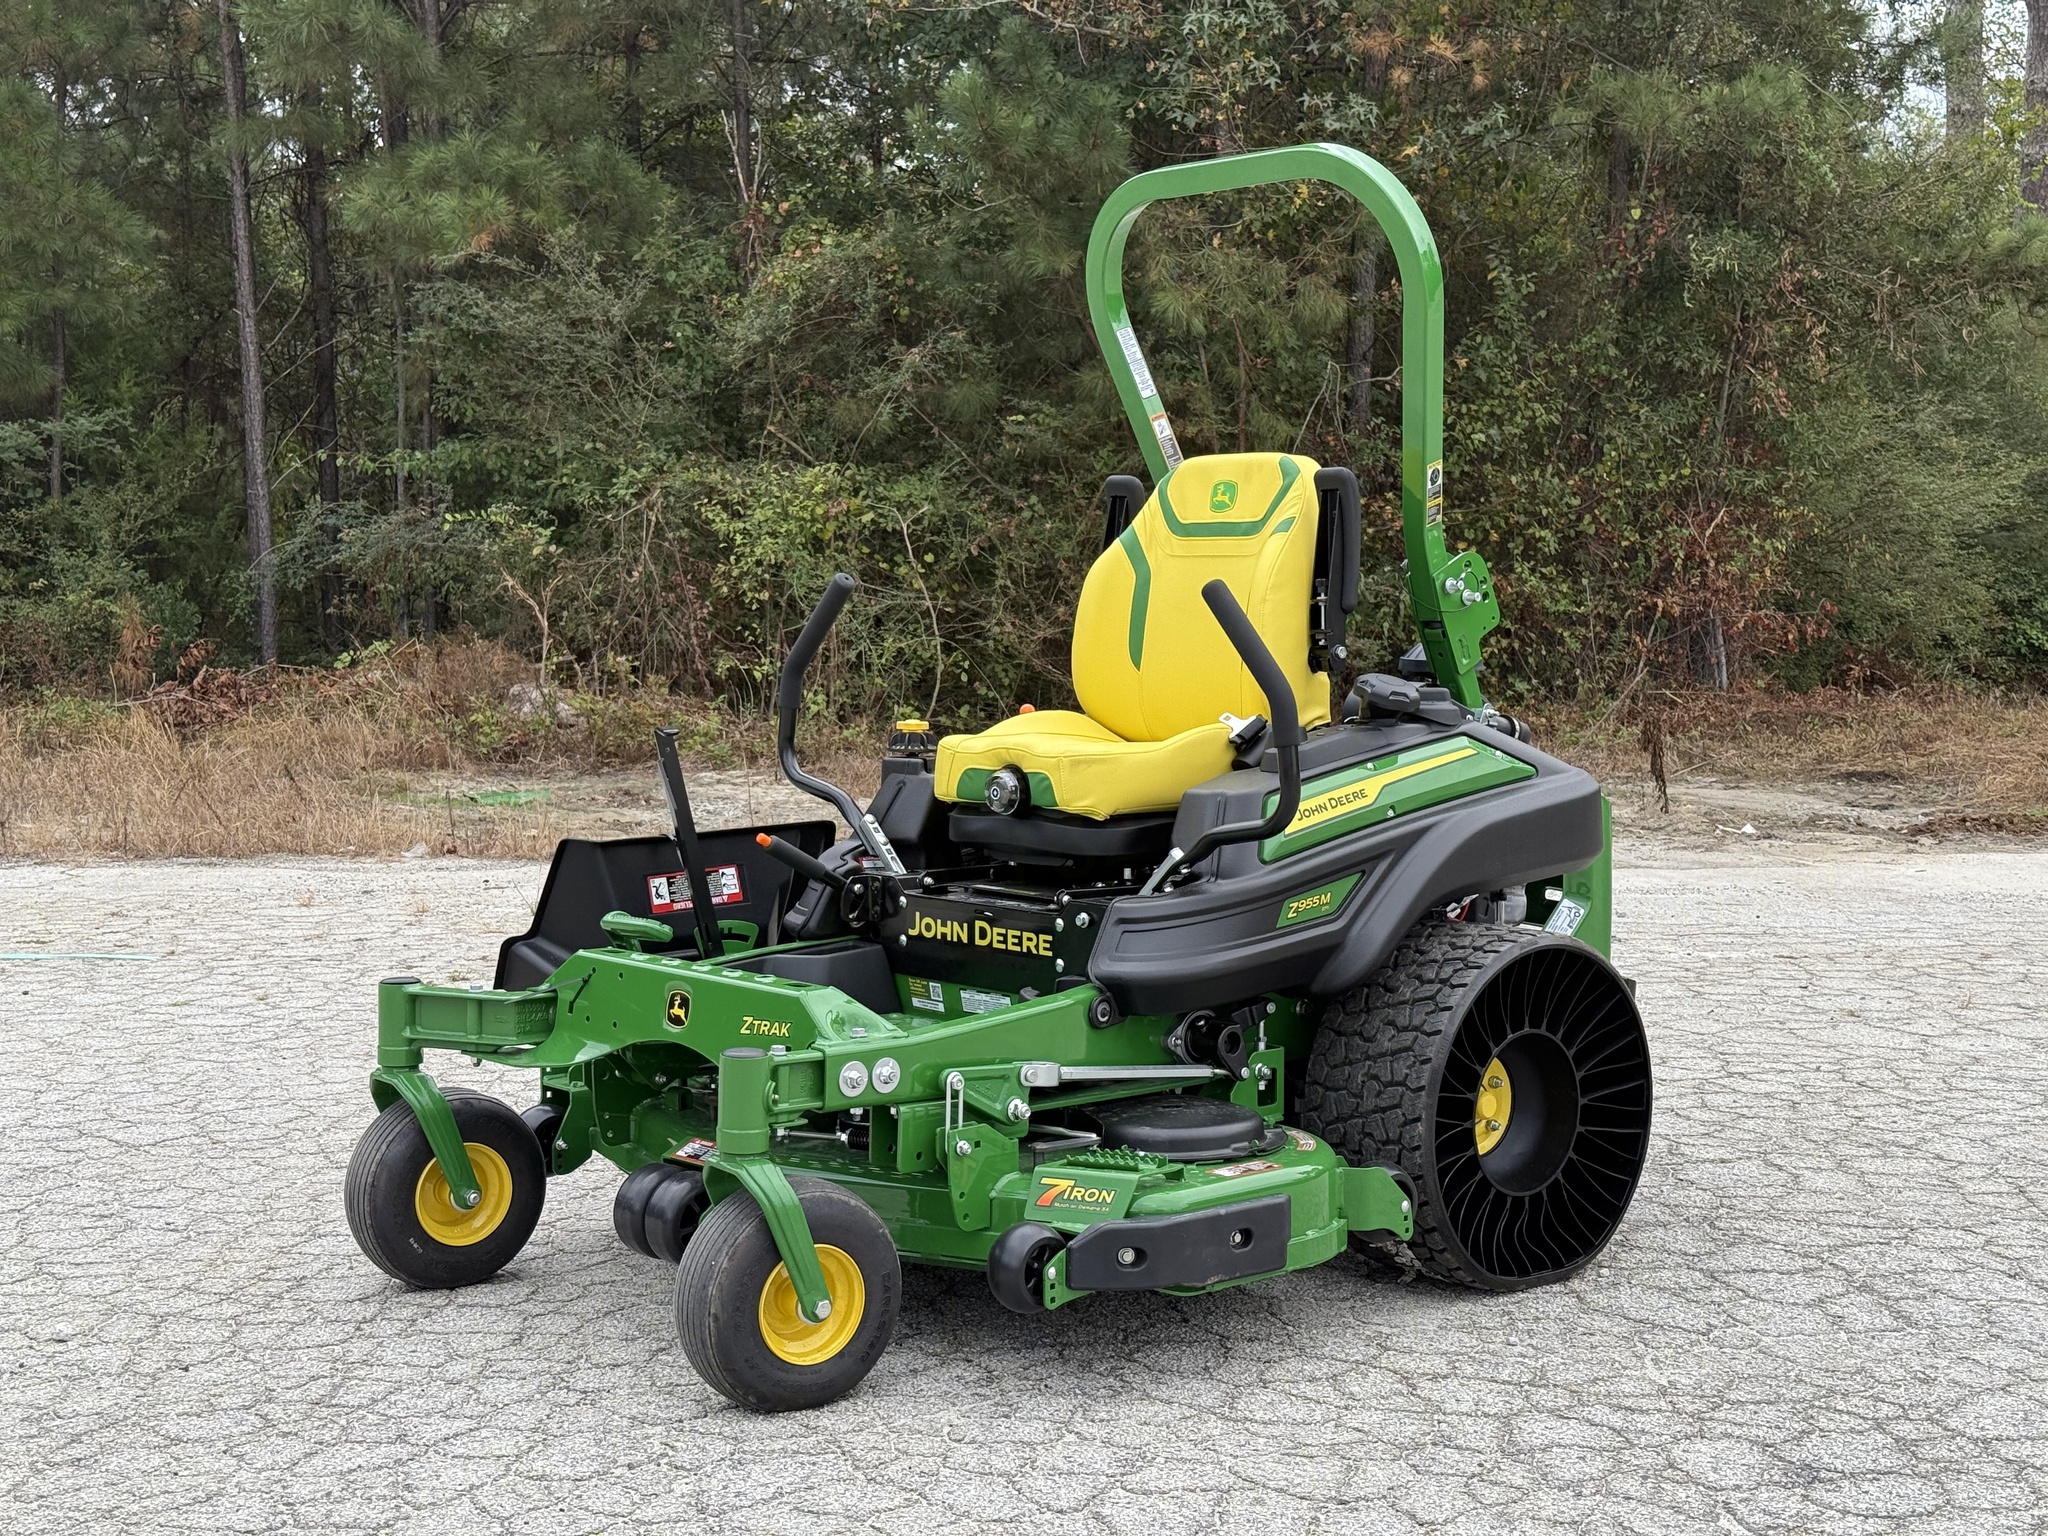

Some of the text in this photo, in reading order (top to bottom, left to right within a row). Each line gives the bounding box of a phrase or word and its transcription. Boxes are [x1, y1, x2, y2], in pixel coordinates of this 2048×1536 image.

[1298, 789, 1368, 821] JOHN DEERE
[1287, 892, 1331, 918] Z955M
[908, 911, 1053, 957] JOHN DEERE
[740, 1016, 791, 1037] ZTRAK
